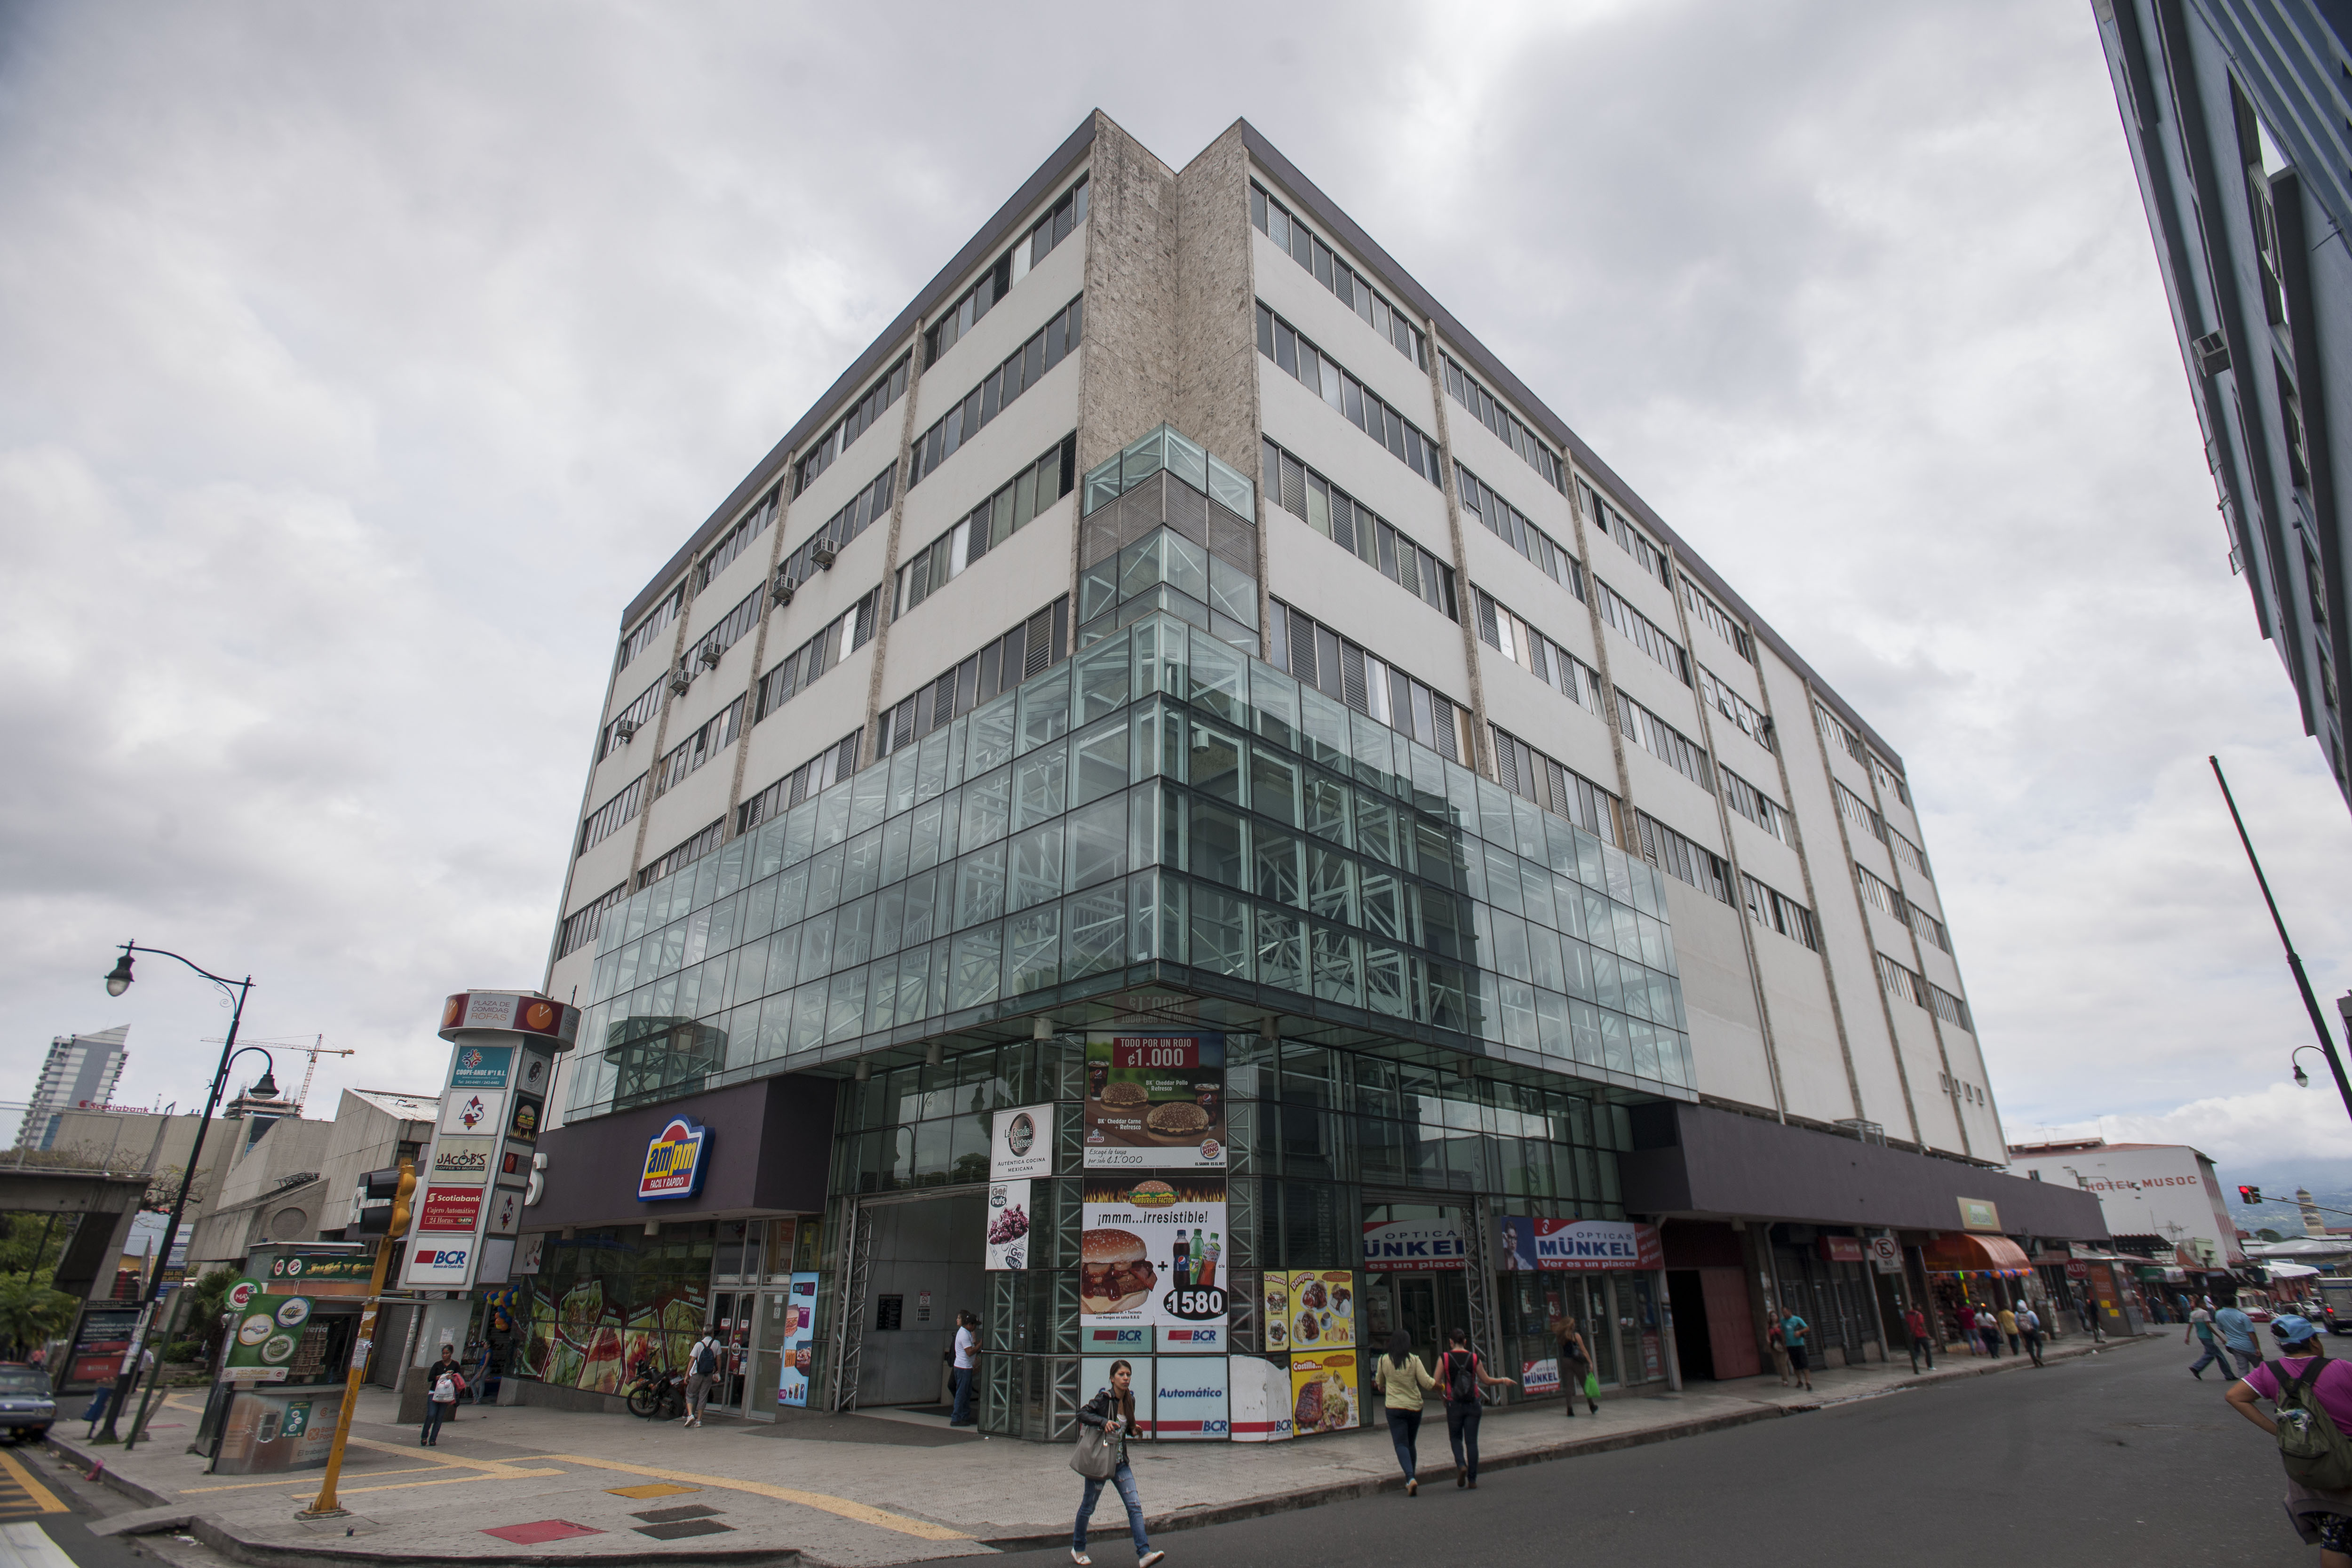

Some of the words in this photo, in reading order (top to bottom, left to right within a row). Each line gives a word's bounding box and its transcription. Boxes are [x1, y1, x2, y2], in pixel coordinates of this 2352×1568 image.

[470, 1012, 507, 1021] ROFAS
[1120, 1038, 1140, 1047] TODO
[1143, 1038, 1158, 1047] POR
[1160, 1038, 1171, 1047] UN
[1173, 1038, 1192, 1047] ROJO
[459, 1099, 485, 1122] AS
[1005, 1129, 1011, 1138] La
[1013, 1126, 1029, 1137] Fonda
[1012, 1137, 1033, 1148] Azteca
[1202, 1142, 1218, 1151] BURGER
[1114, 1148, 1127, 1158] tuya
[1203, 1146, 1219, 1156] KING
[650, 1179, 662, 1189] FACIL
[666, 1177, 684, 1187] RAPIDO
[2142, 1175, 2197, 1188] MUSOC
[500, 1200, 514, 1221] AS
[1385, 1230, 1465, 1239] OPTICA
[1539, 1237, 1635, 1256] MÜNKEL
[435, 1251, 466, 1264] BCR
[1419, 1260, 1466, 1269] place
[1602, 1260, 1636, 1268] placer
[2067, 1263, 2086, 1273] ALTO
[1271, 1276, 1286, 1285] Nuevo
[1291, 1272, 1314, 1291] Desayuno
[1118, 1330, 1142, 1341] BCR
[1192, 1330, 1216, 1341] BCR
[1525, 1372, 1557, 1385] MÜNKEL
[1159, 1387, 1222, 1398] Automático
[1203, 1420, 1227, 1432] BCR
[1276, 1419, 1292, 1431] BCR
